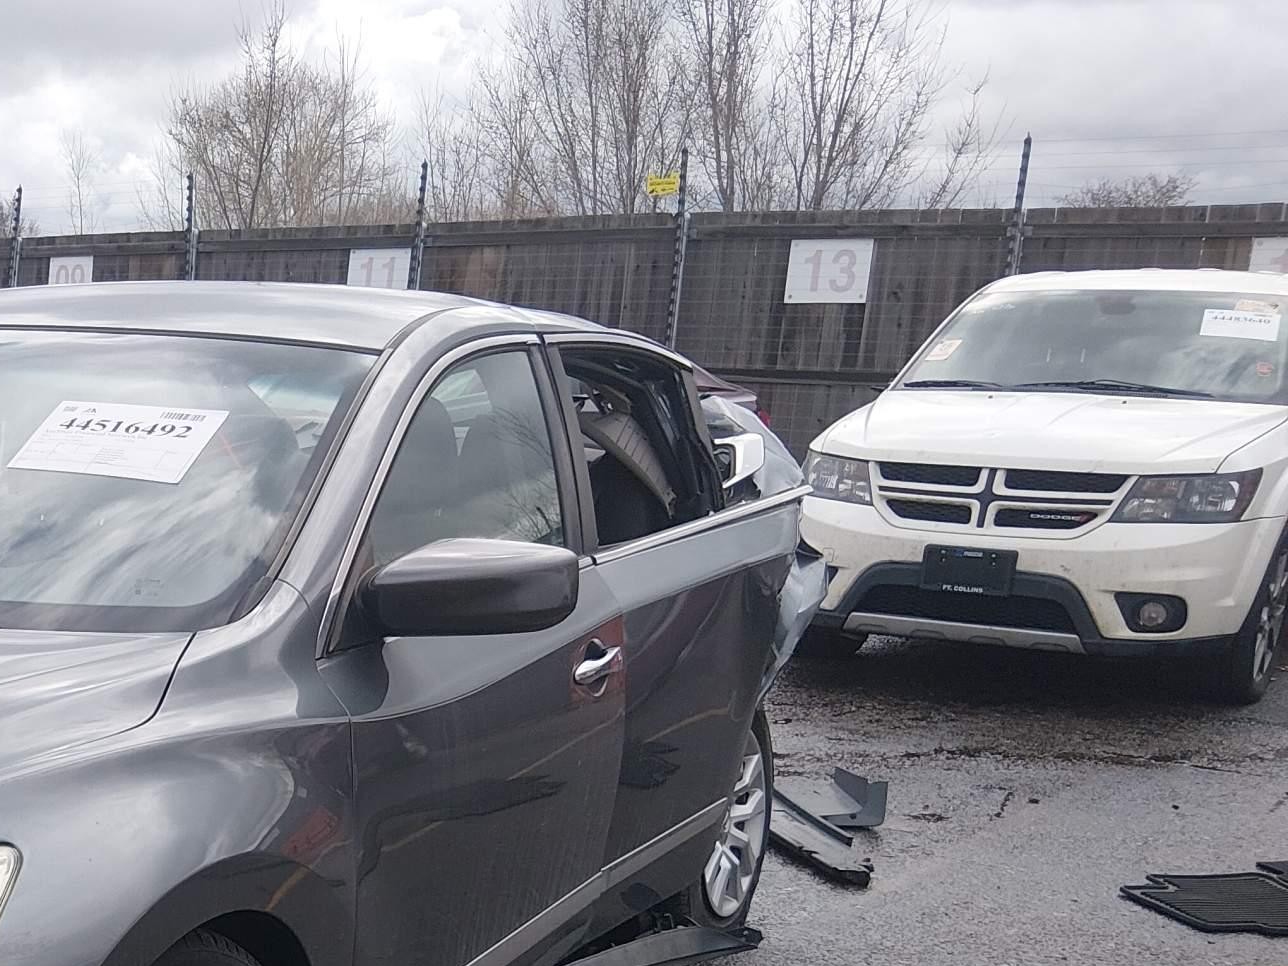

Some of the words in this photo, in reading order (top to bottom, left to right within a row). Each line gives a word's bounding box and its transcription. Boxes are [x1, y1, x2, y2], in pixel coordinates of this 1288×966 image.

[360, 256, 396, 289] 11
[804, 249, 857, 293] 13
[59, 417, 193, 438] 44516492
[1029, 513, 1082, 522] DODGE
[953, 585, 984, 593] COLLINS
